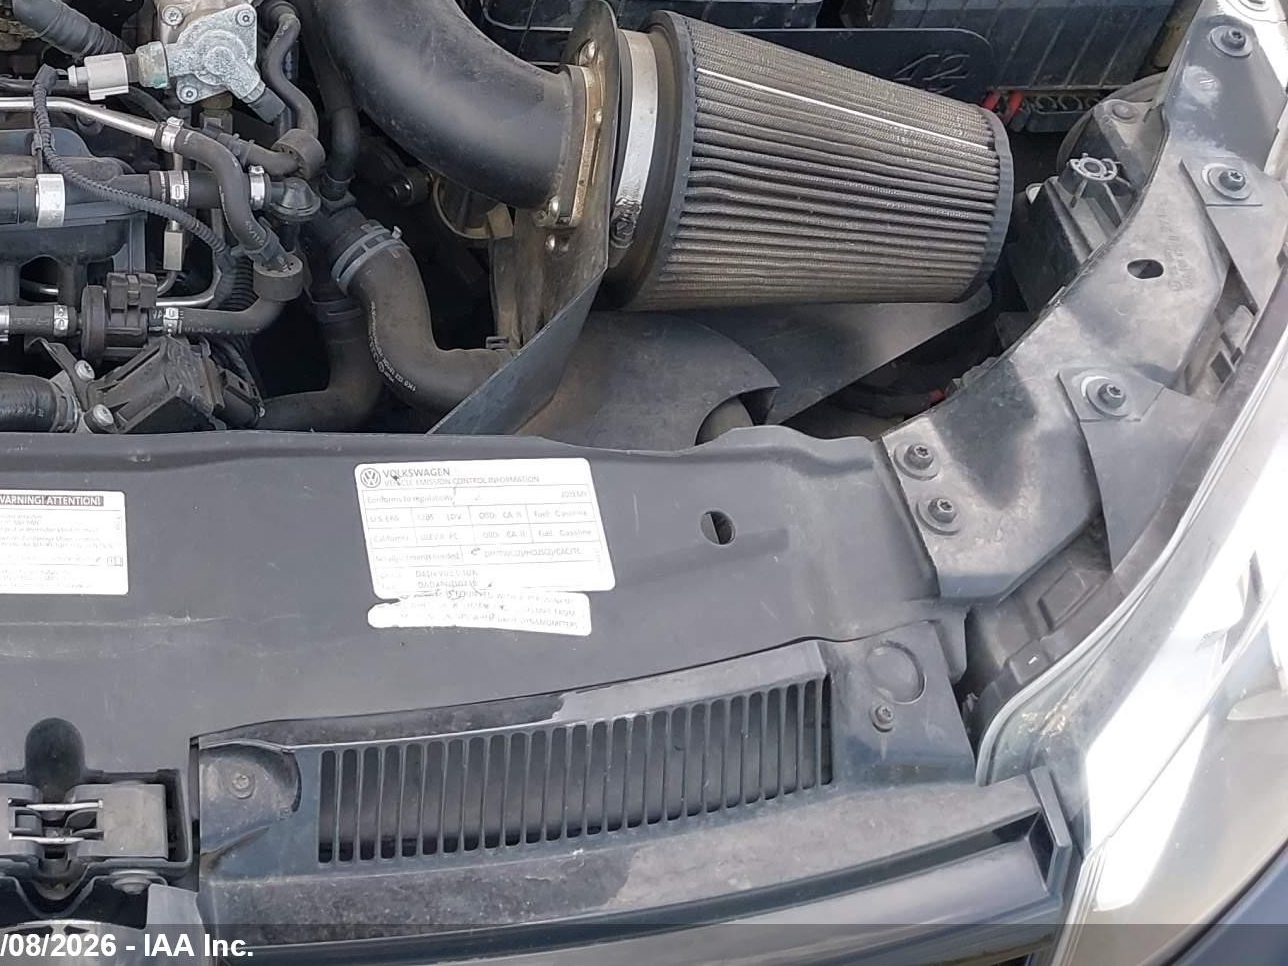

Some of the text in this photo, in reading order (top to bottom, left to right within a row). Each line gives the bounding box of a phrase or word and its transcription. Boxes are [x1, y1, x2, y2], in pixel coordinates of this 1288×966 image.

[382, 467, 451, 479] VOLKSWAGEN
[452, 476, 487, 485] CONTROL
[488, 475, 540, 484] INFORMATION
[46, 496, 102, 506] ATTENTION!
